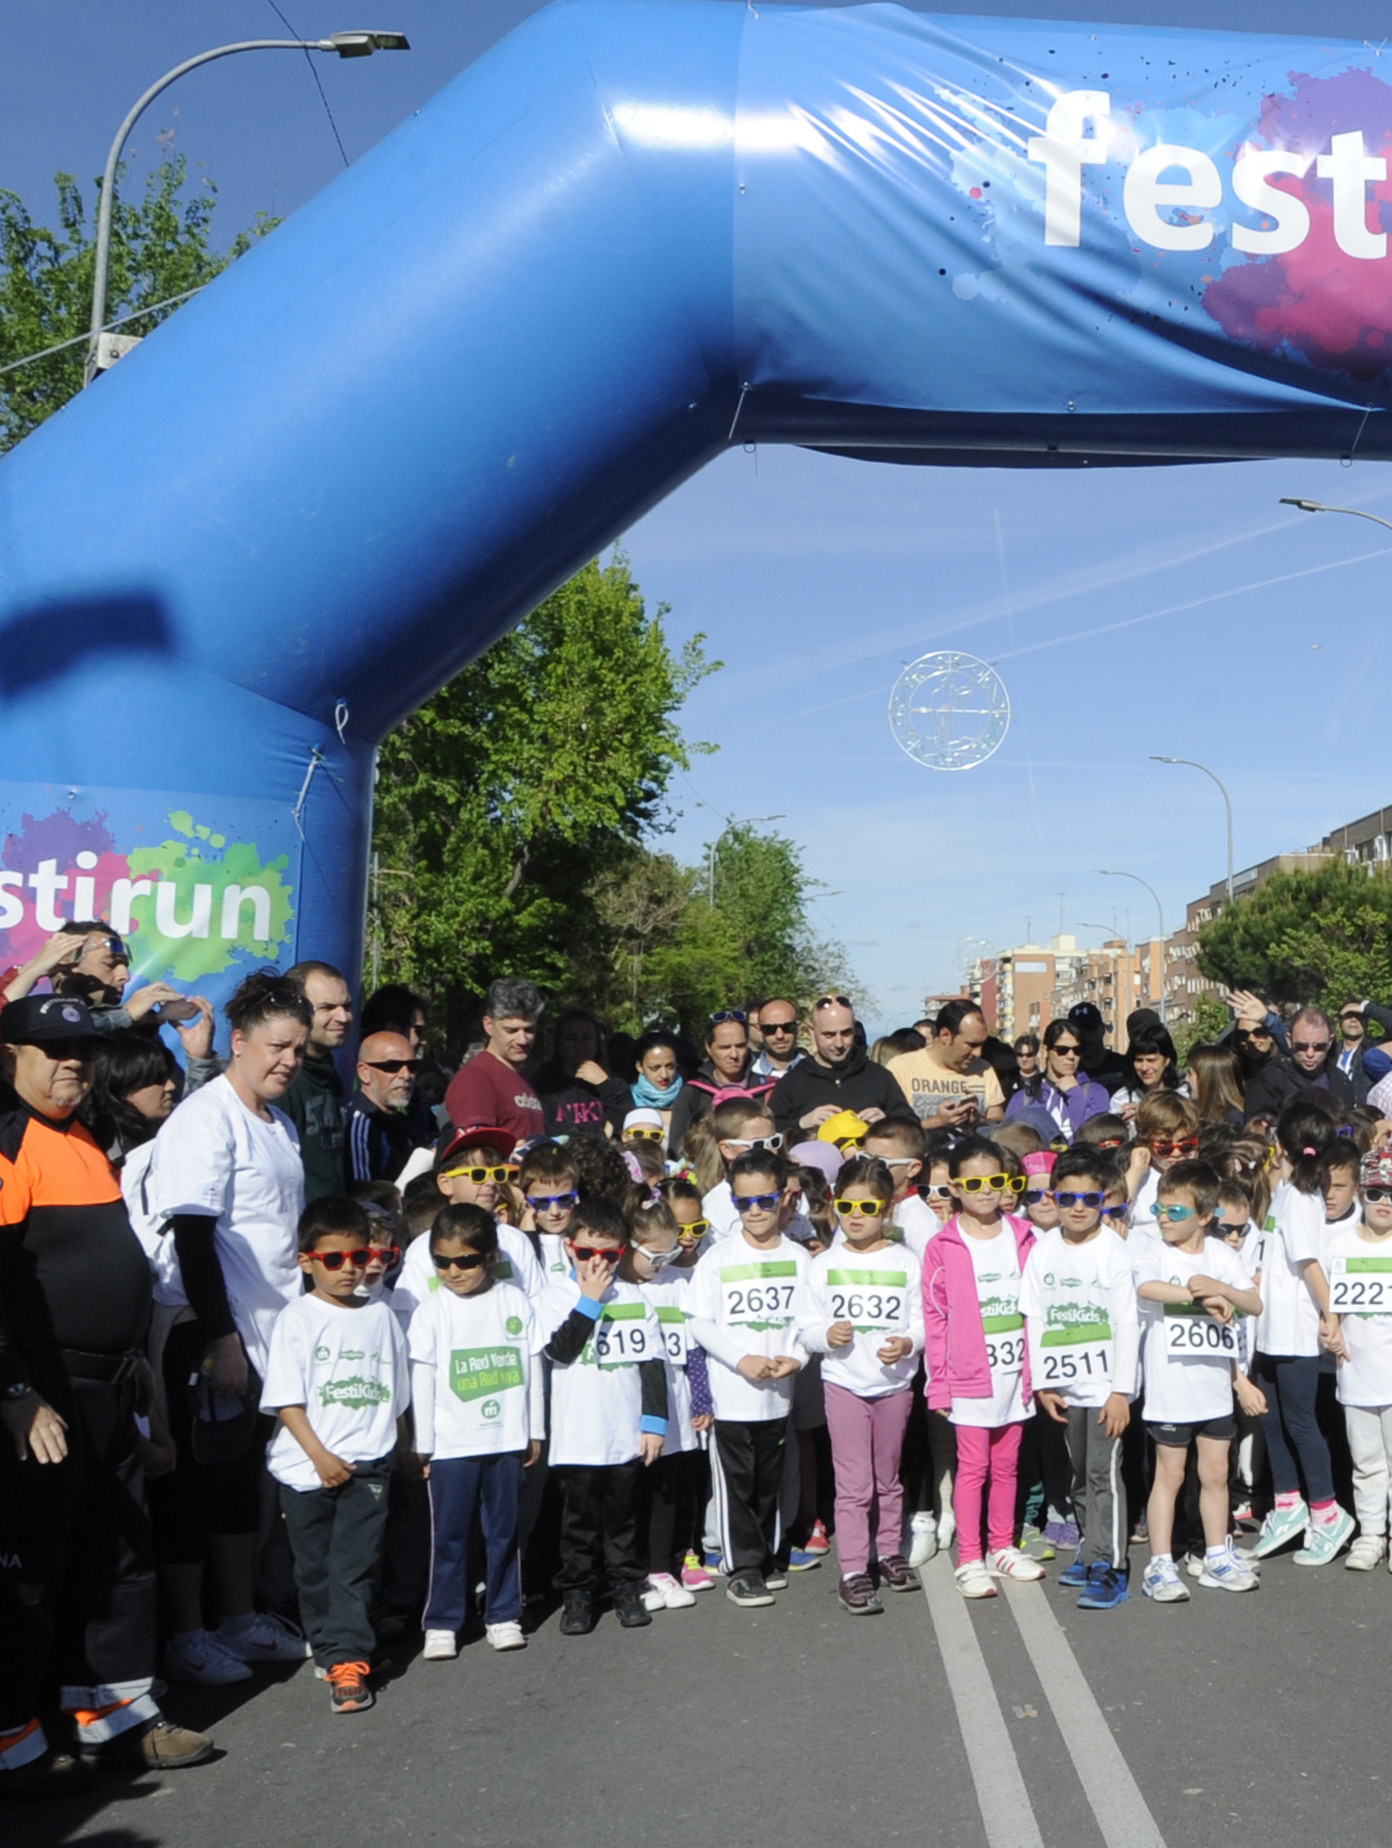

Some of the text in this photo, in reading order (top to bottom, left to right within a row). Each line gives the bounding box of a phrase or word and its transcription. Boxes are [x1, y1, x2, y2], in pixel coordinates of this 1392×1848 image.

[911, 1077, 967, 1094] ORANGE
[728, 1286, 795, 1315] 2637
[831, 1294, 901, 1320] 2632
[1169, 1322, 1234, 1350] 2606
[455, 1359, 467, 1374] La
[468, 1354, 490, 1372] Red
[1043, 1349, 1108, 1380] 2511
[457, 1377, 478, 1391] una
[479, 1370, 499, 1387] Red
